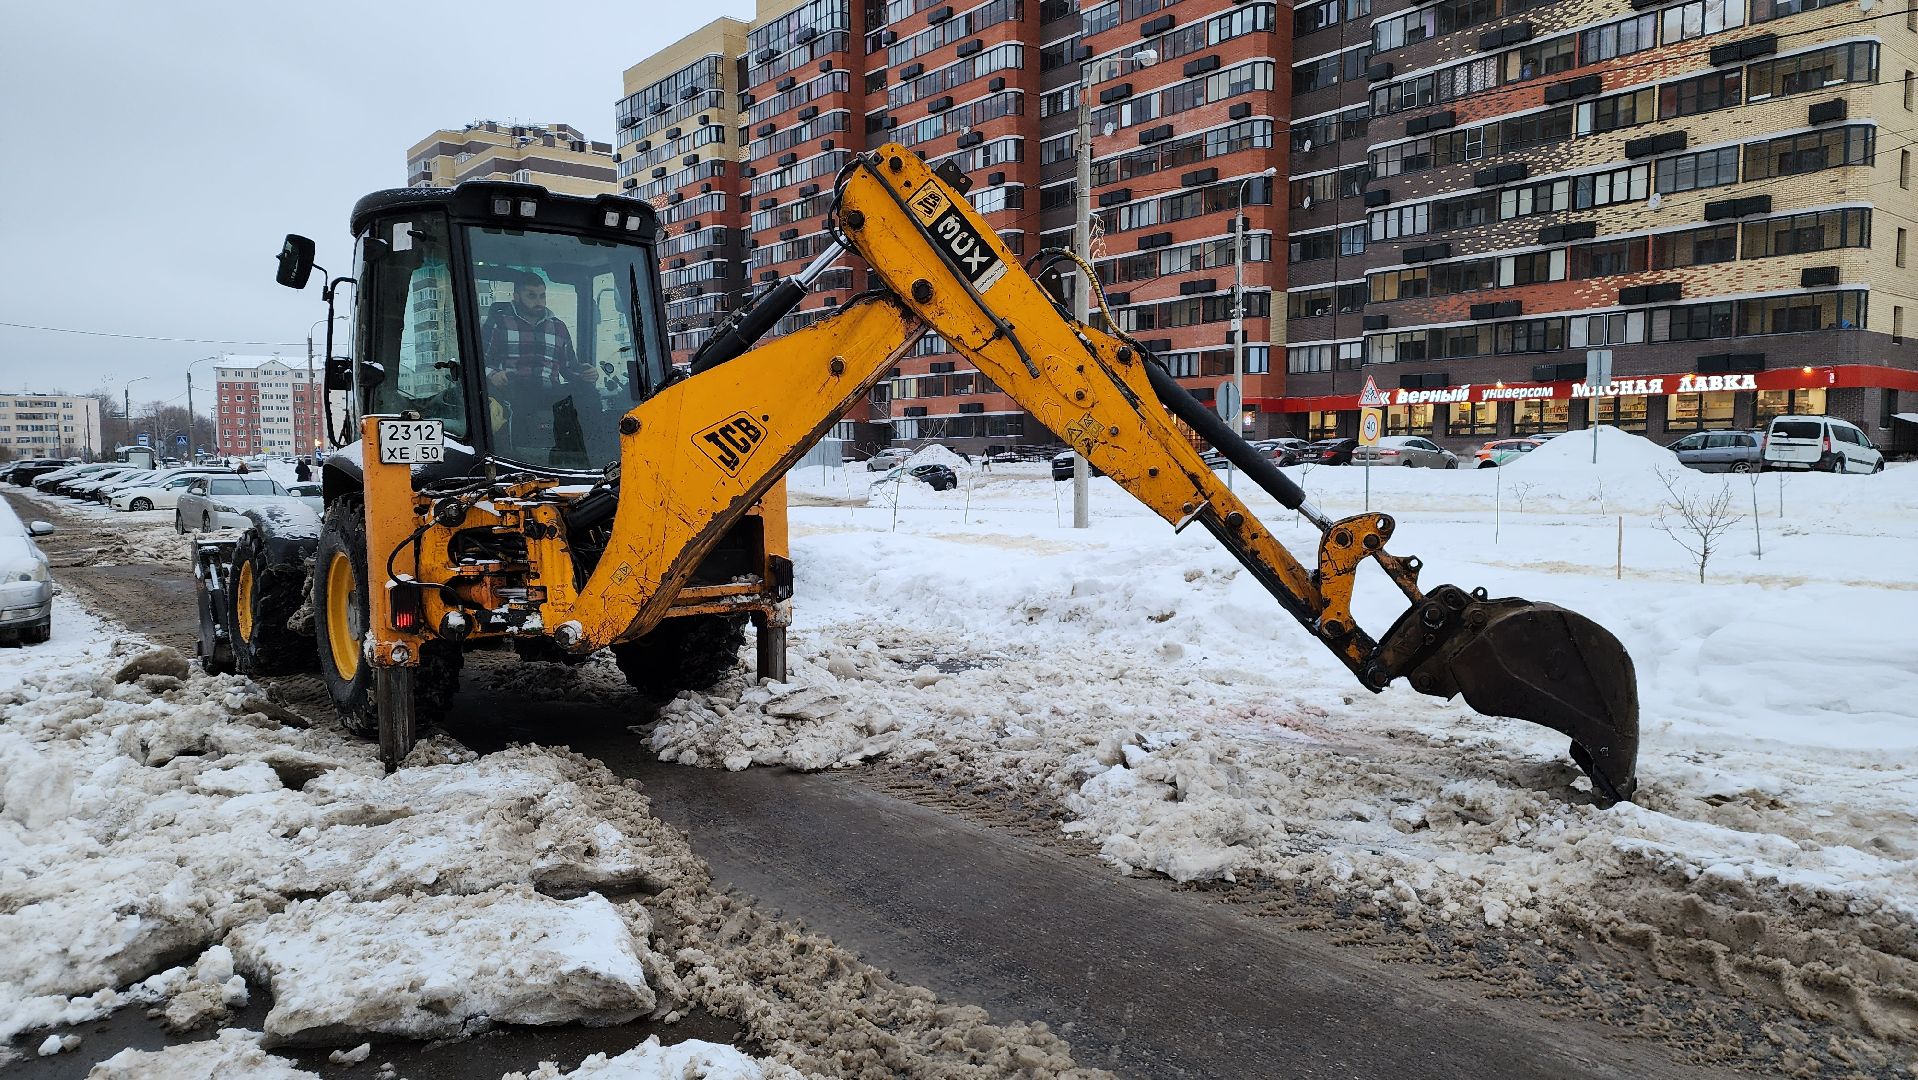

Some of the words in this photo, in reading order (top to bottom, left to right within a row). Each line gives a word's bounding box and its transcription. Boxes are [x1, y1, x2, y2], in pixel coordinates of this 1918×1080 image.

[917, 193, 942, 214] JCB
[1677, 374, 1757, 392] ЛАВКА
[1482, 386, 1554, 401] универсам
[388, 424, 436, 441] 2312
[1366, 420, 1376, 432] 40
[703, 417, 762, 471] JCB
[387, 446, 410, 460] ХЕ
[421, 446, 439, 460] 50
